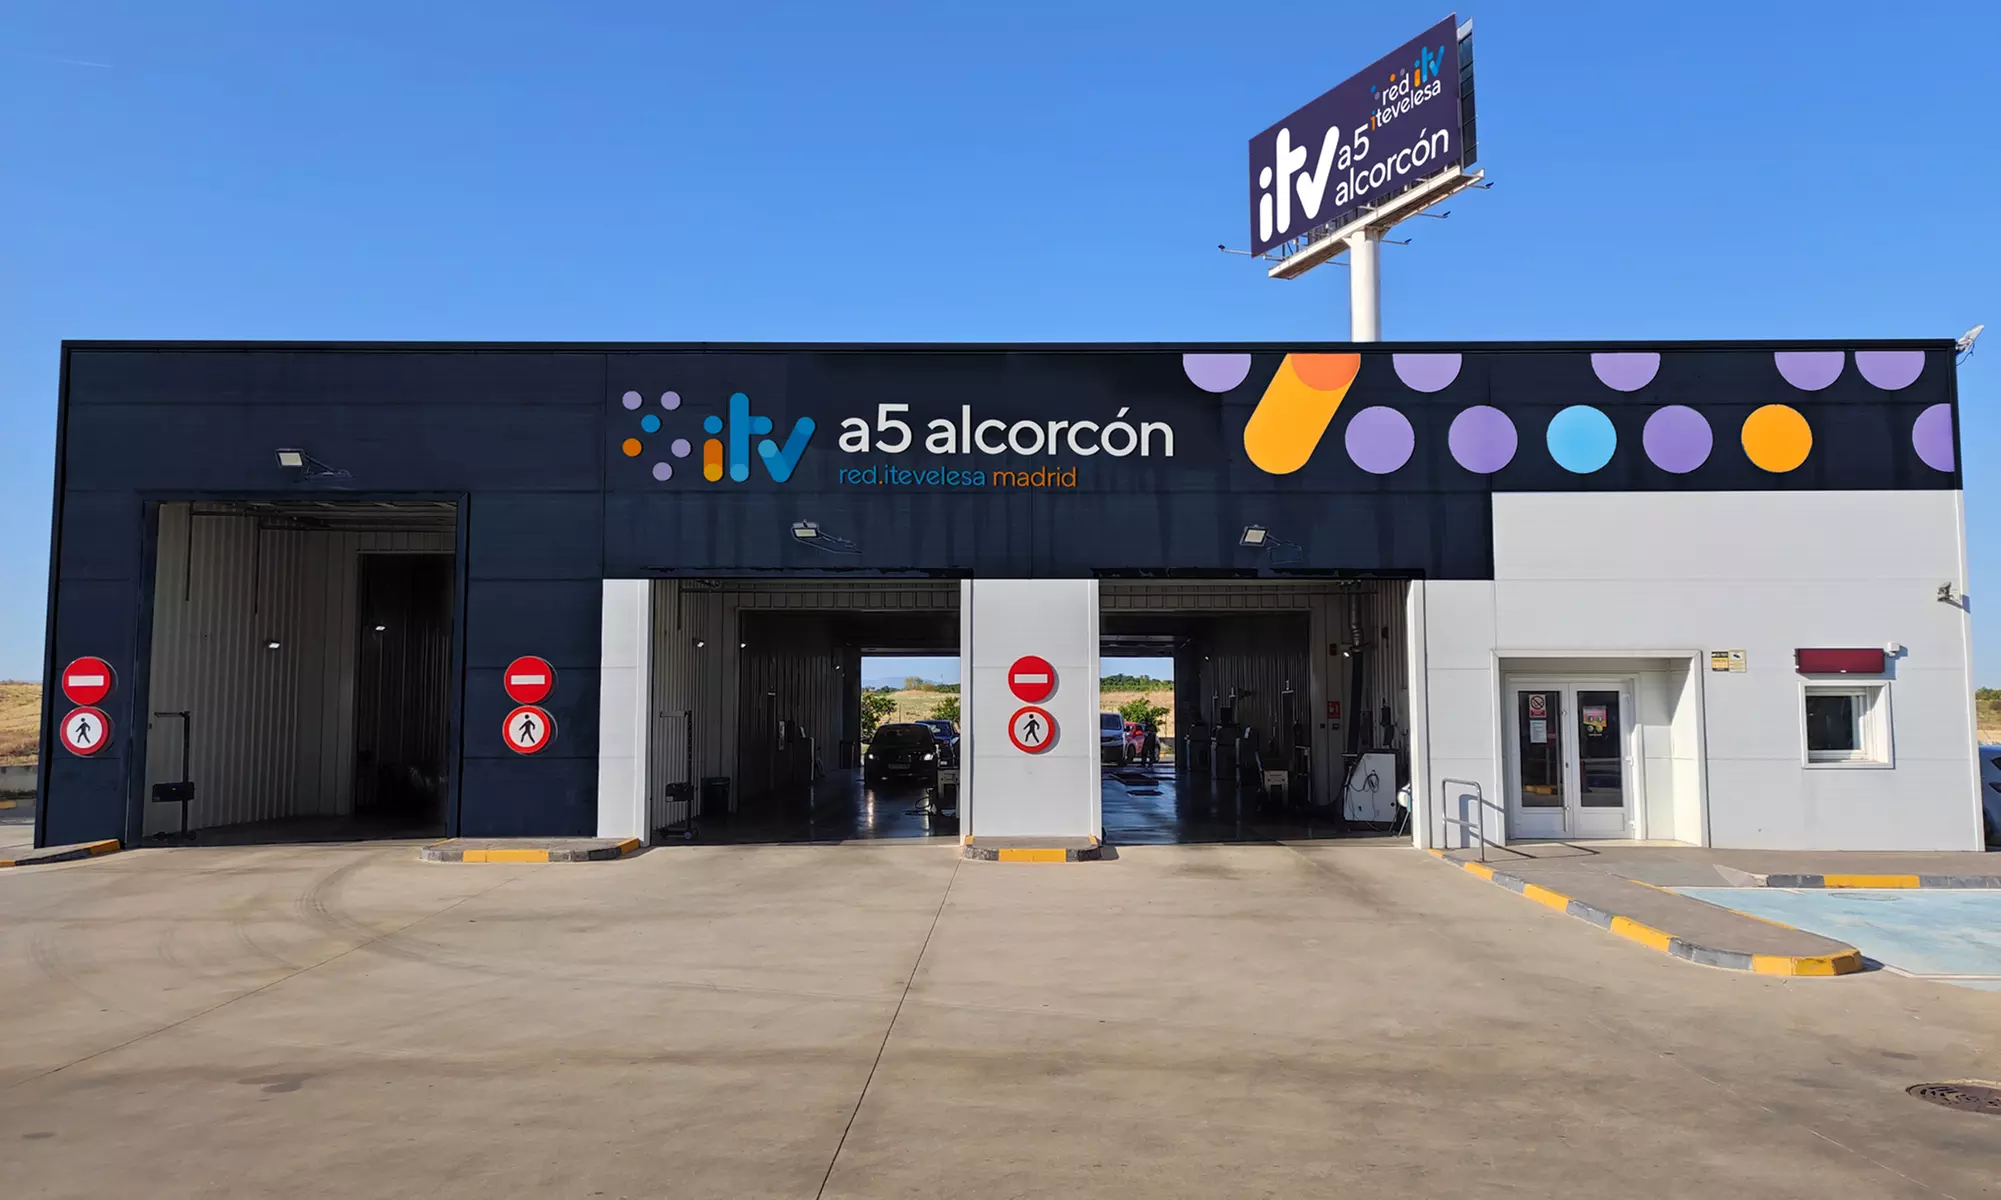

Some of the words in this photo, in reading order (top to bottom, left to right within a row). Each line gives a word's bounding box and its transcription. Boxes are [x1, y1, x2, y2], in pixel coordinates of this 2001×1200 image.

[1382, 72, 1409, 106] red
[1414, 45, 1445, 87] itv
[1370, 80, 1441, 131] itevelesa
[1335, 128, 1449, 207] alcorcón
[1337, 123, 1370, 171] a5
[1259, 125, 1340, 243] itv
[703, 392, 816, 483] itv
[838, 403, 913, 454] a5
[925, 404, 1174, 457] alcorcón
[839, 465, 986, 486] red.itevelesa
[993, 466, 1077, 488] madrid
